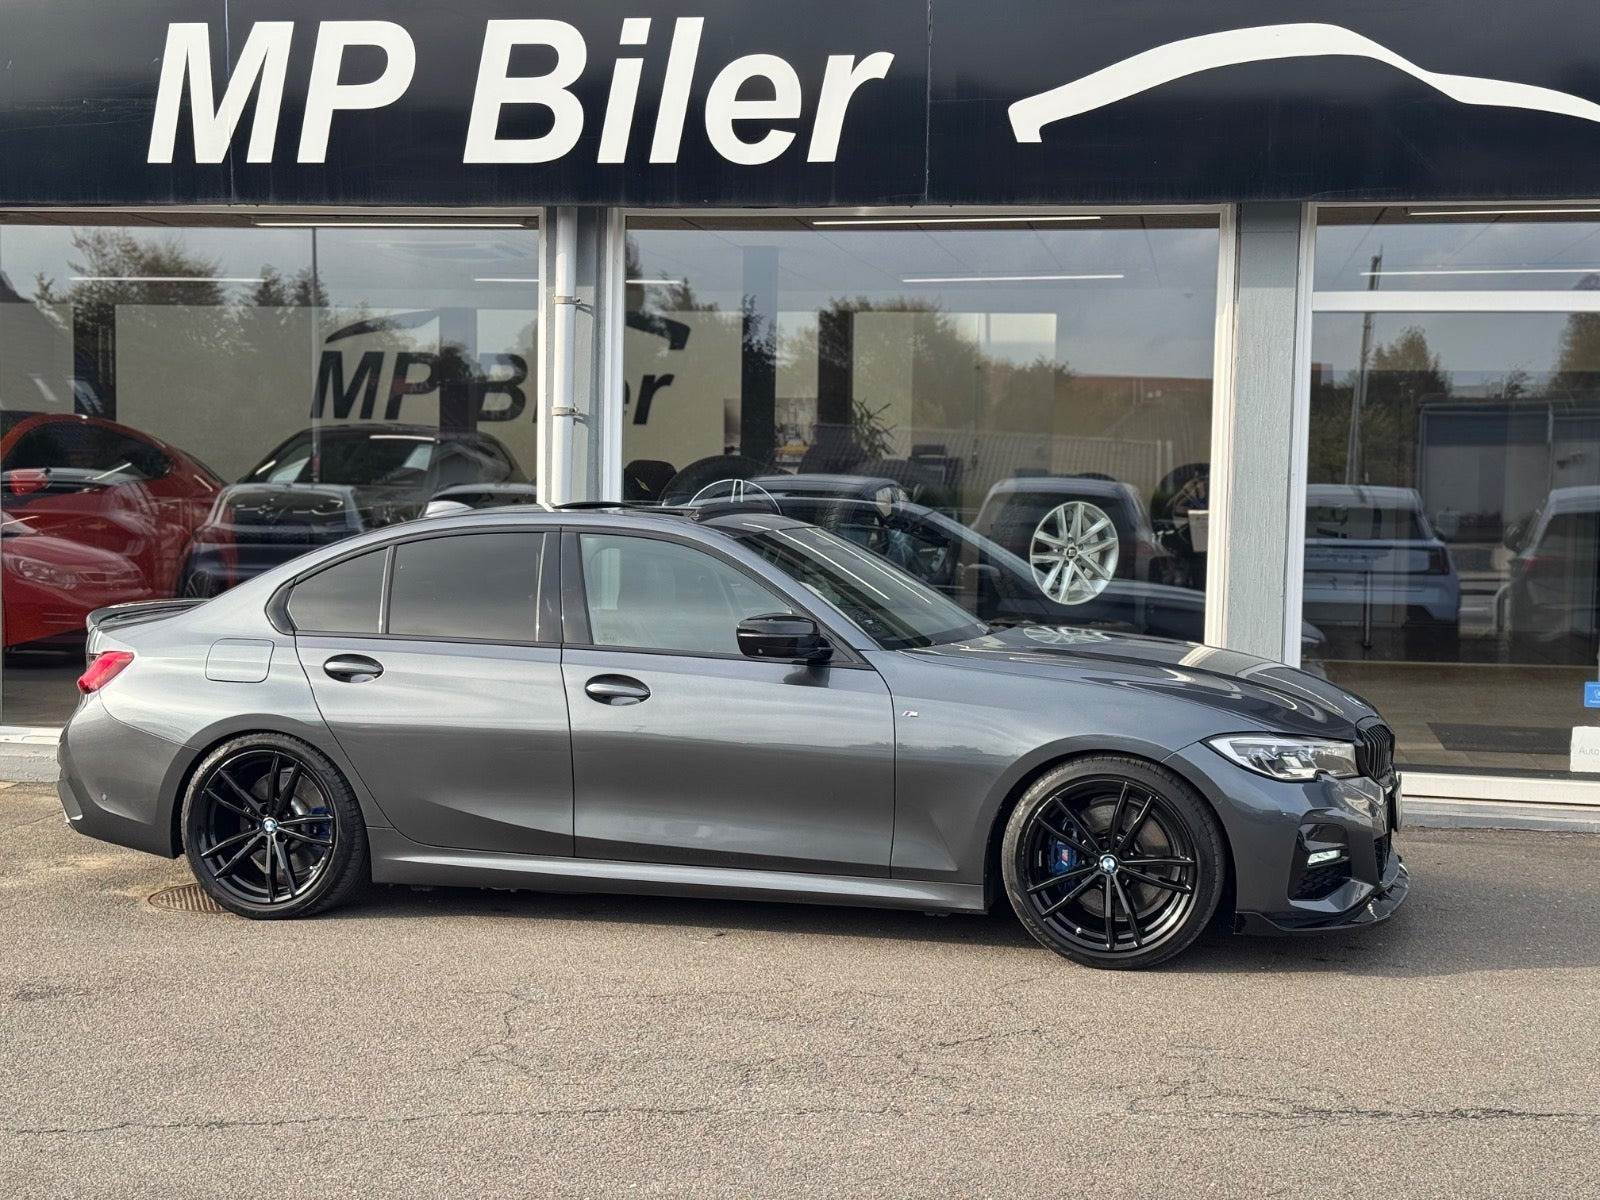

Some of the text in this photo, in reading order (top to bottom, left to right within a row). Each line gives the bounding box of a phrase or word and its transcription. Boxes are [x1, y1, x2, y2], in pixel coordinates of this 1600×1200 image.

[147, 16, 895, 165] MP Biler
[310, 350, 439, 421] MP
